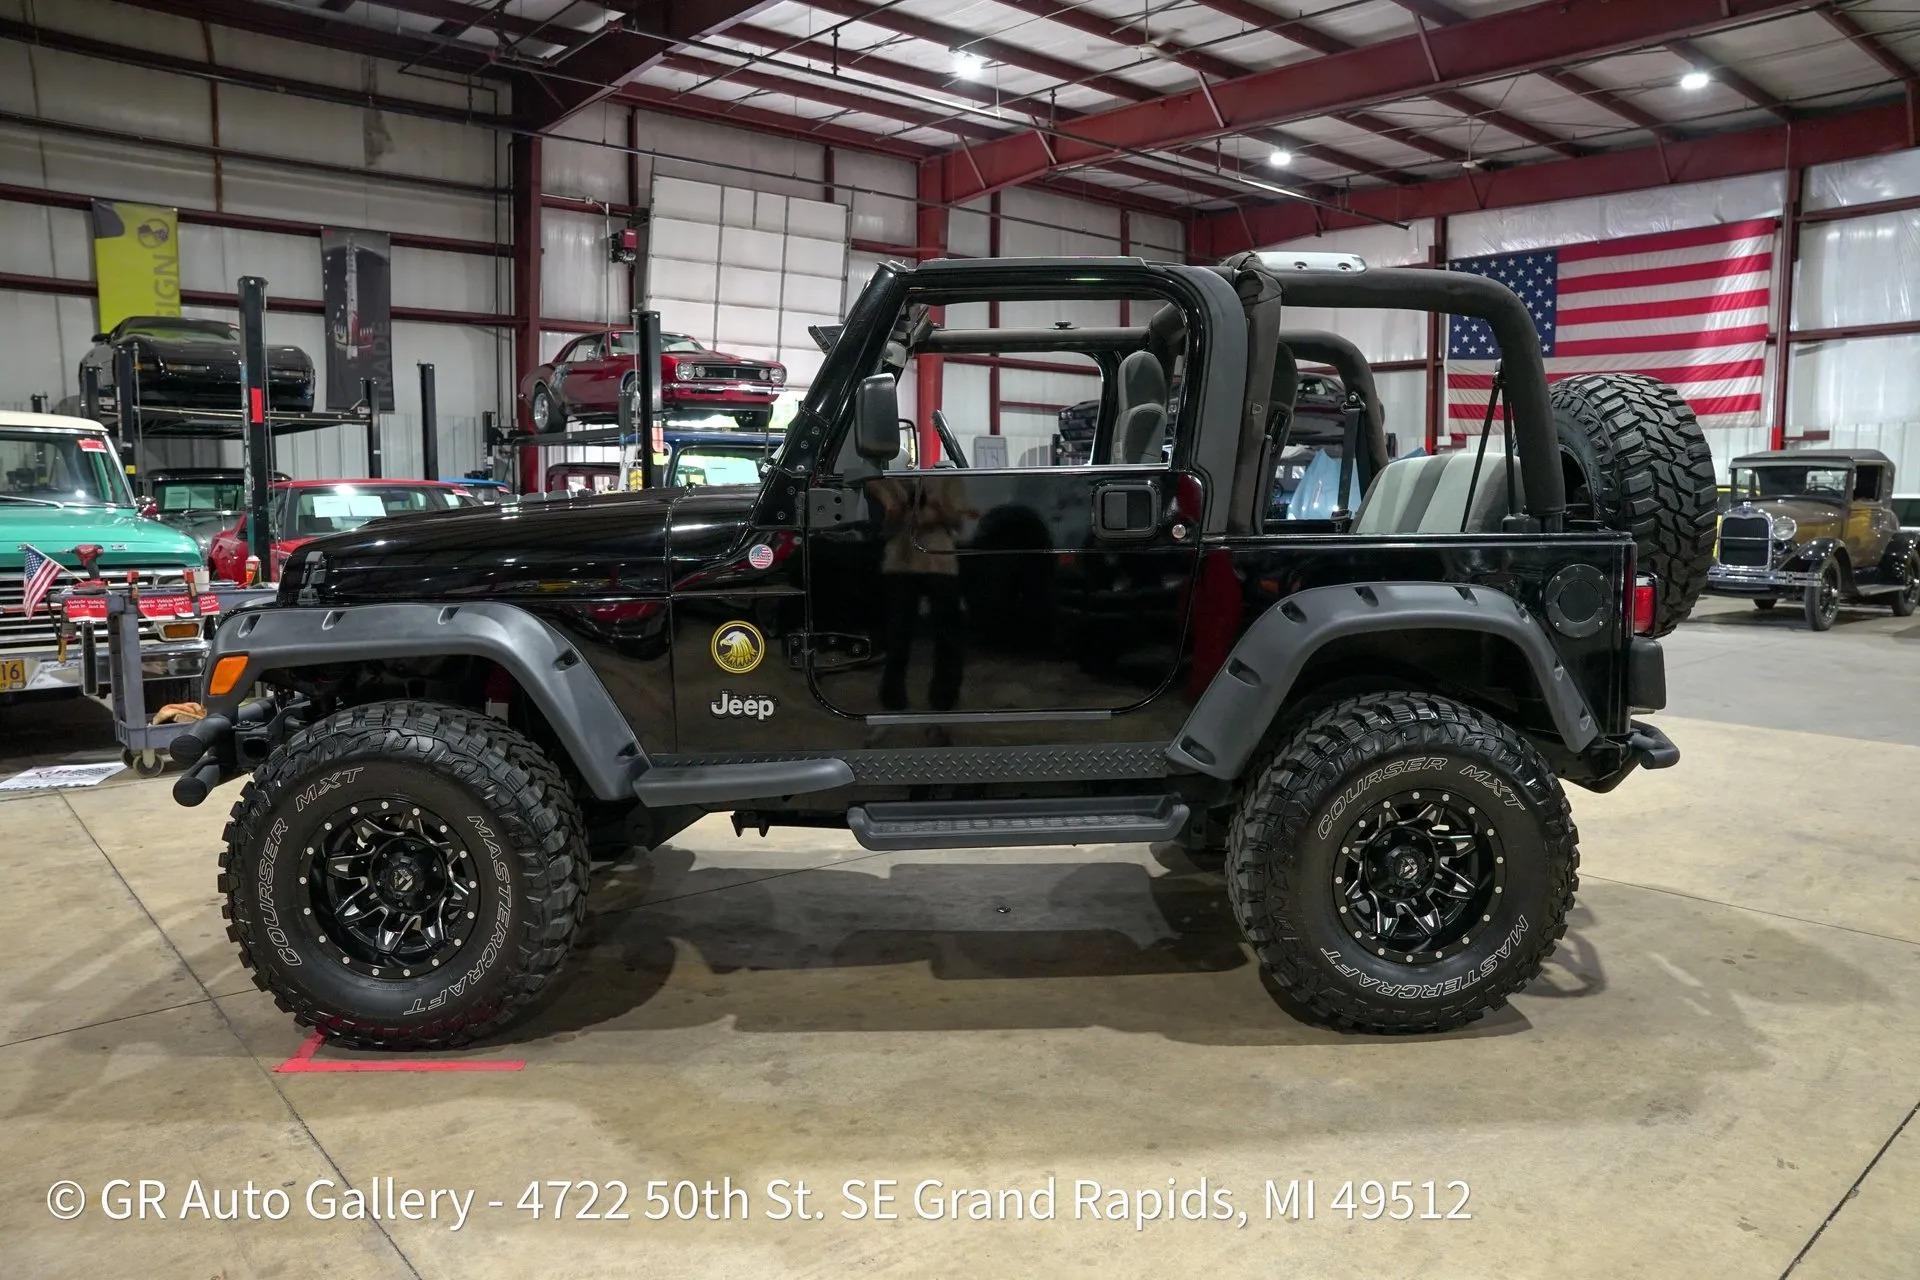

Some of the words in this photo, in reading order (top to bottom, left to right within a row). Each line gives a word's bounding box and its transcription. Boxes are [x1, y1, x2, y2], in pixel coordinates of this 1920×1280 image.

[711, 691, 775, 720] Jeep
[1317, 756, 1448, 841] COURSER
[1460, 764, 1526, 812] MXT
[256, 817, 303, 967] COURSER
[294, 766, 364, 813] MXT
[403, 814, 512, 1016] MASTERCRAFT
[1320, 913, 1529, 1000] MASTERCRAFT
